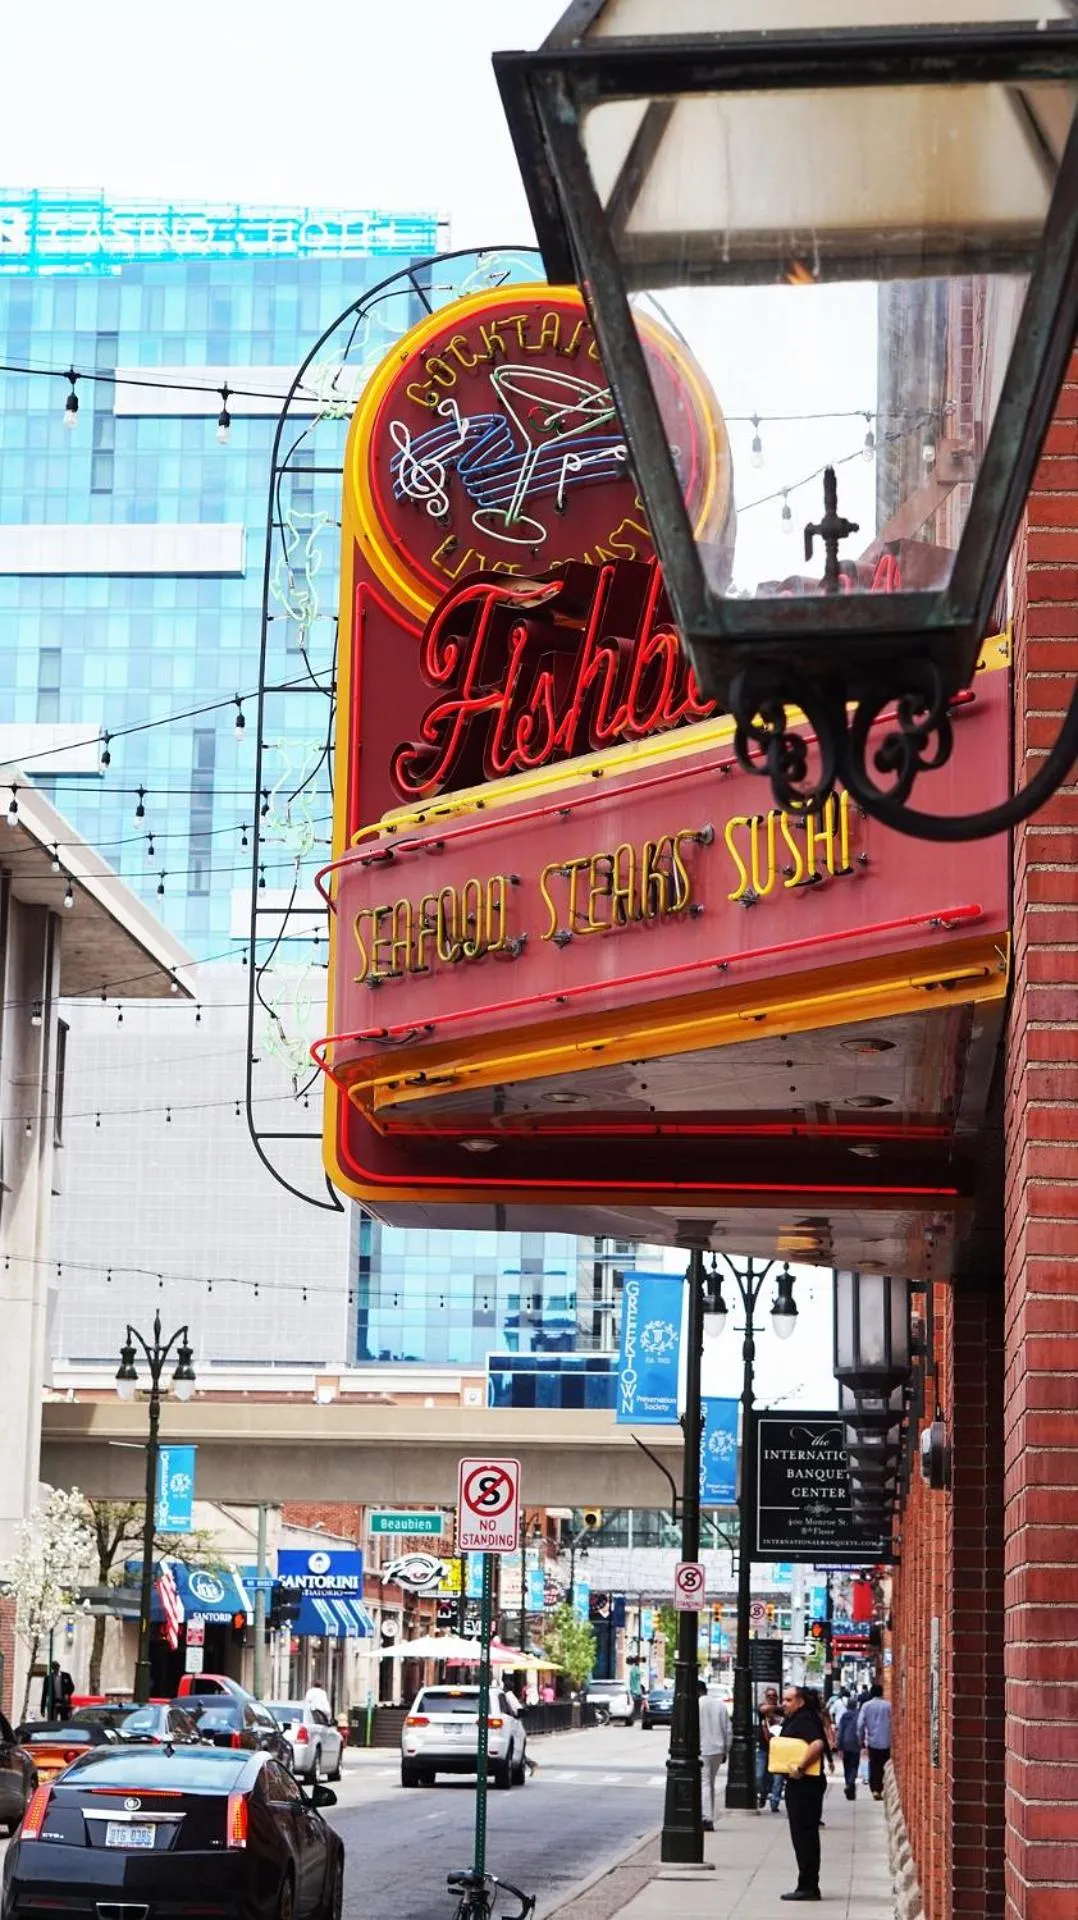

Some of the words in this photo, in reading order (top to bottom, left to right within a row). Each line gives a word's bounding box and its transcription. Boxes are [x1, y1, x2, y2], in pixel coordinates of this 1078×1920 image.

[51, 219, 214, 252] CASINO
[353, 875, 508, 983] SEAFOOD
[541, 829, 700, 940] STEAKS
[724, 788, 850, 901] SUSHI
[620, 1280, 640, 1414] GREEKTOWN
[791, 1487, 846, 1498] CENTER
[380, 1518, 432, 1530] Beaubien
[479, 1519, 496, 1532] NO
[462, 1534, 513, 1547] STANDING
[278, 1575, 359, 1589] SANTORINI
